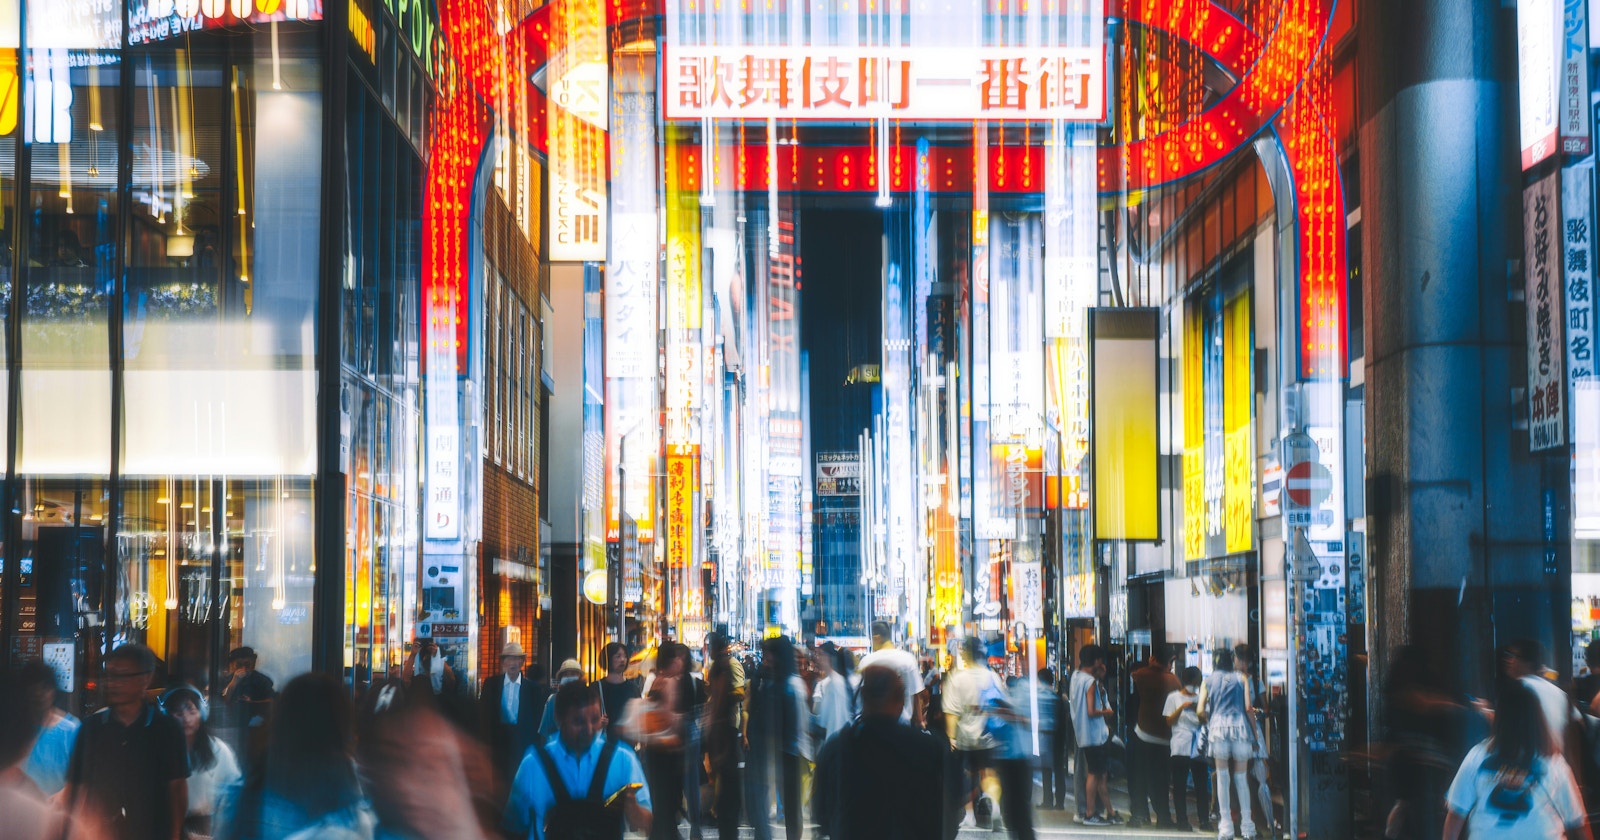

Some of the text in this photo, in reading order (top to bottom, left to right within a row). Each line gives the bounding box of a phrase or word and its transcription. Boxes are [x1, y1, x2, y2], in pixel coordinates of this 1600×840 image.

[1567, 62, 1580, 132] 新宿東口駅前
[1535, 194, 1550, 376] お好み焼き
[1532, 381, 1559, 423] 本陣
[1533, 421, 1558, 447] HONJIN
[435, 434, 452, 528] 劇場通り
